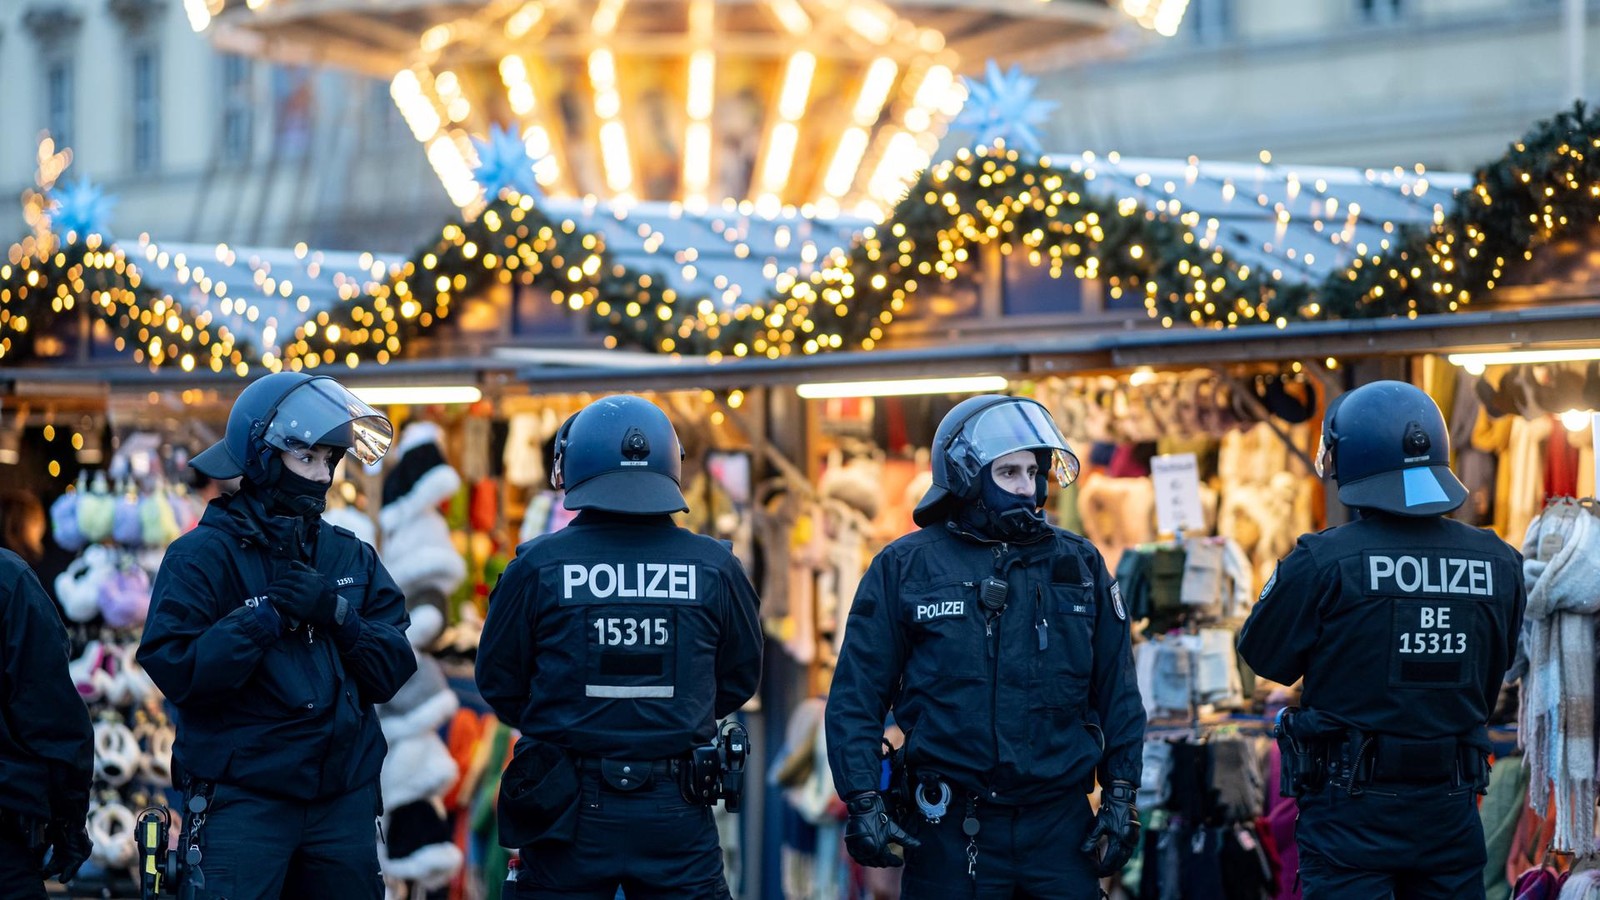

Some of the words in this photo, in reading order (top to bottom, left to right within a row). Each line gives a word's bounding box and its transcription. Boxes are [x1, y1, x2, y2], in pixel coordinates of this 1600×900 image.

[563, 563, 697, 600] POLIZEI
[1369, 555, 1493, 596] POLIZEI
[917, 601, 965, 620] POLIZEI
[1420, 607, 1451, 629] BE
[593, 617, 669, 646] 15315
[1399, 632, 1467, 654] 15313
